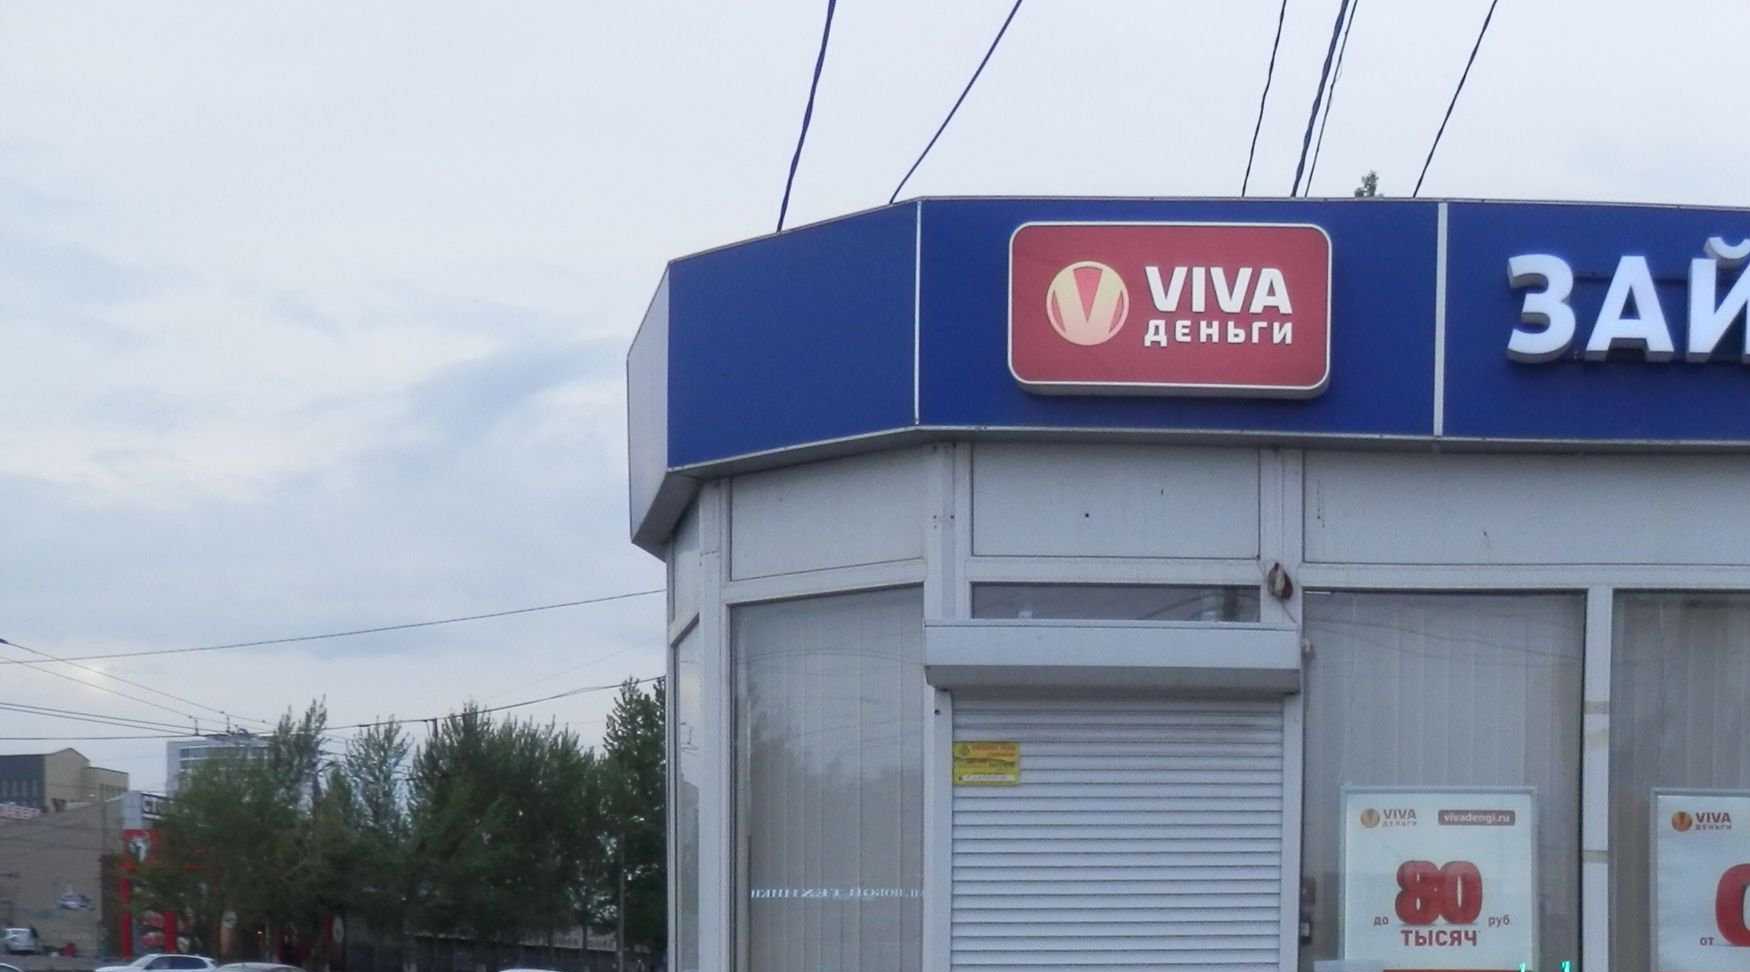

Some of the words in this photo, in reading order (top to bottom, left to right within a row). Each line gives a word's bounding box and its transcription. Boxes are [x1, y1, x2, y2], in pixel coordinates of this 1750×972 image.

[1145, 266, 1292, 314] VIVA
[1144, 319, 1292, 347] ДЕНЬГИ
[1383, 808, 1417, 820] VIVA
[1695, 811, 1731, 823] VIVA
[1373, 916, 1389, 927] до
[1395, 860, 1483, 926] 80
[1488, 914, 1511, 928] руб
[1400, 929, 1479, 947] ТЫСЯЧ
[1700, 937, 1715, 946] от
